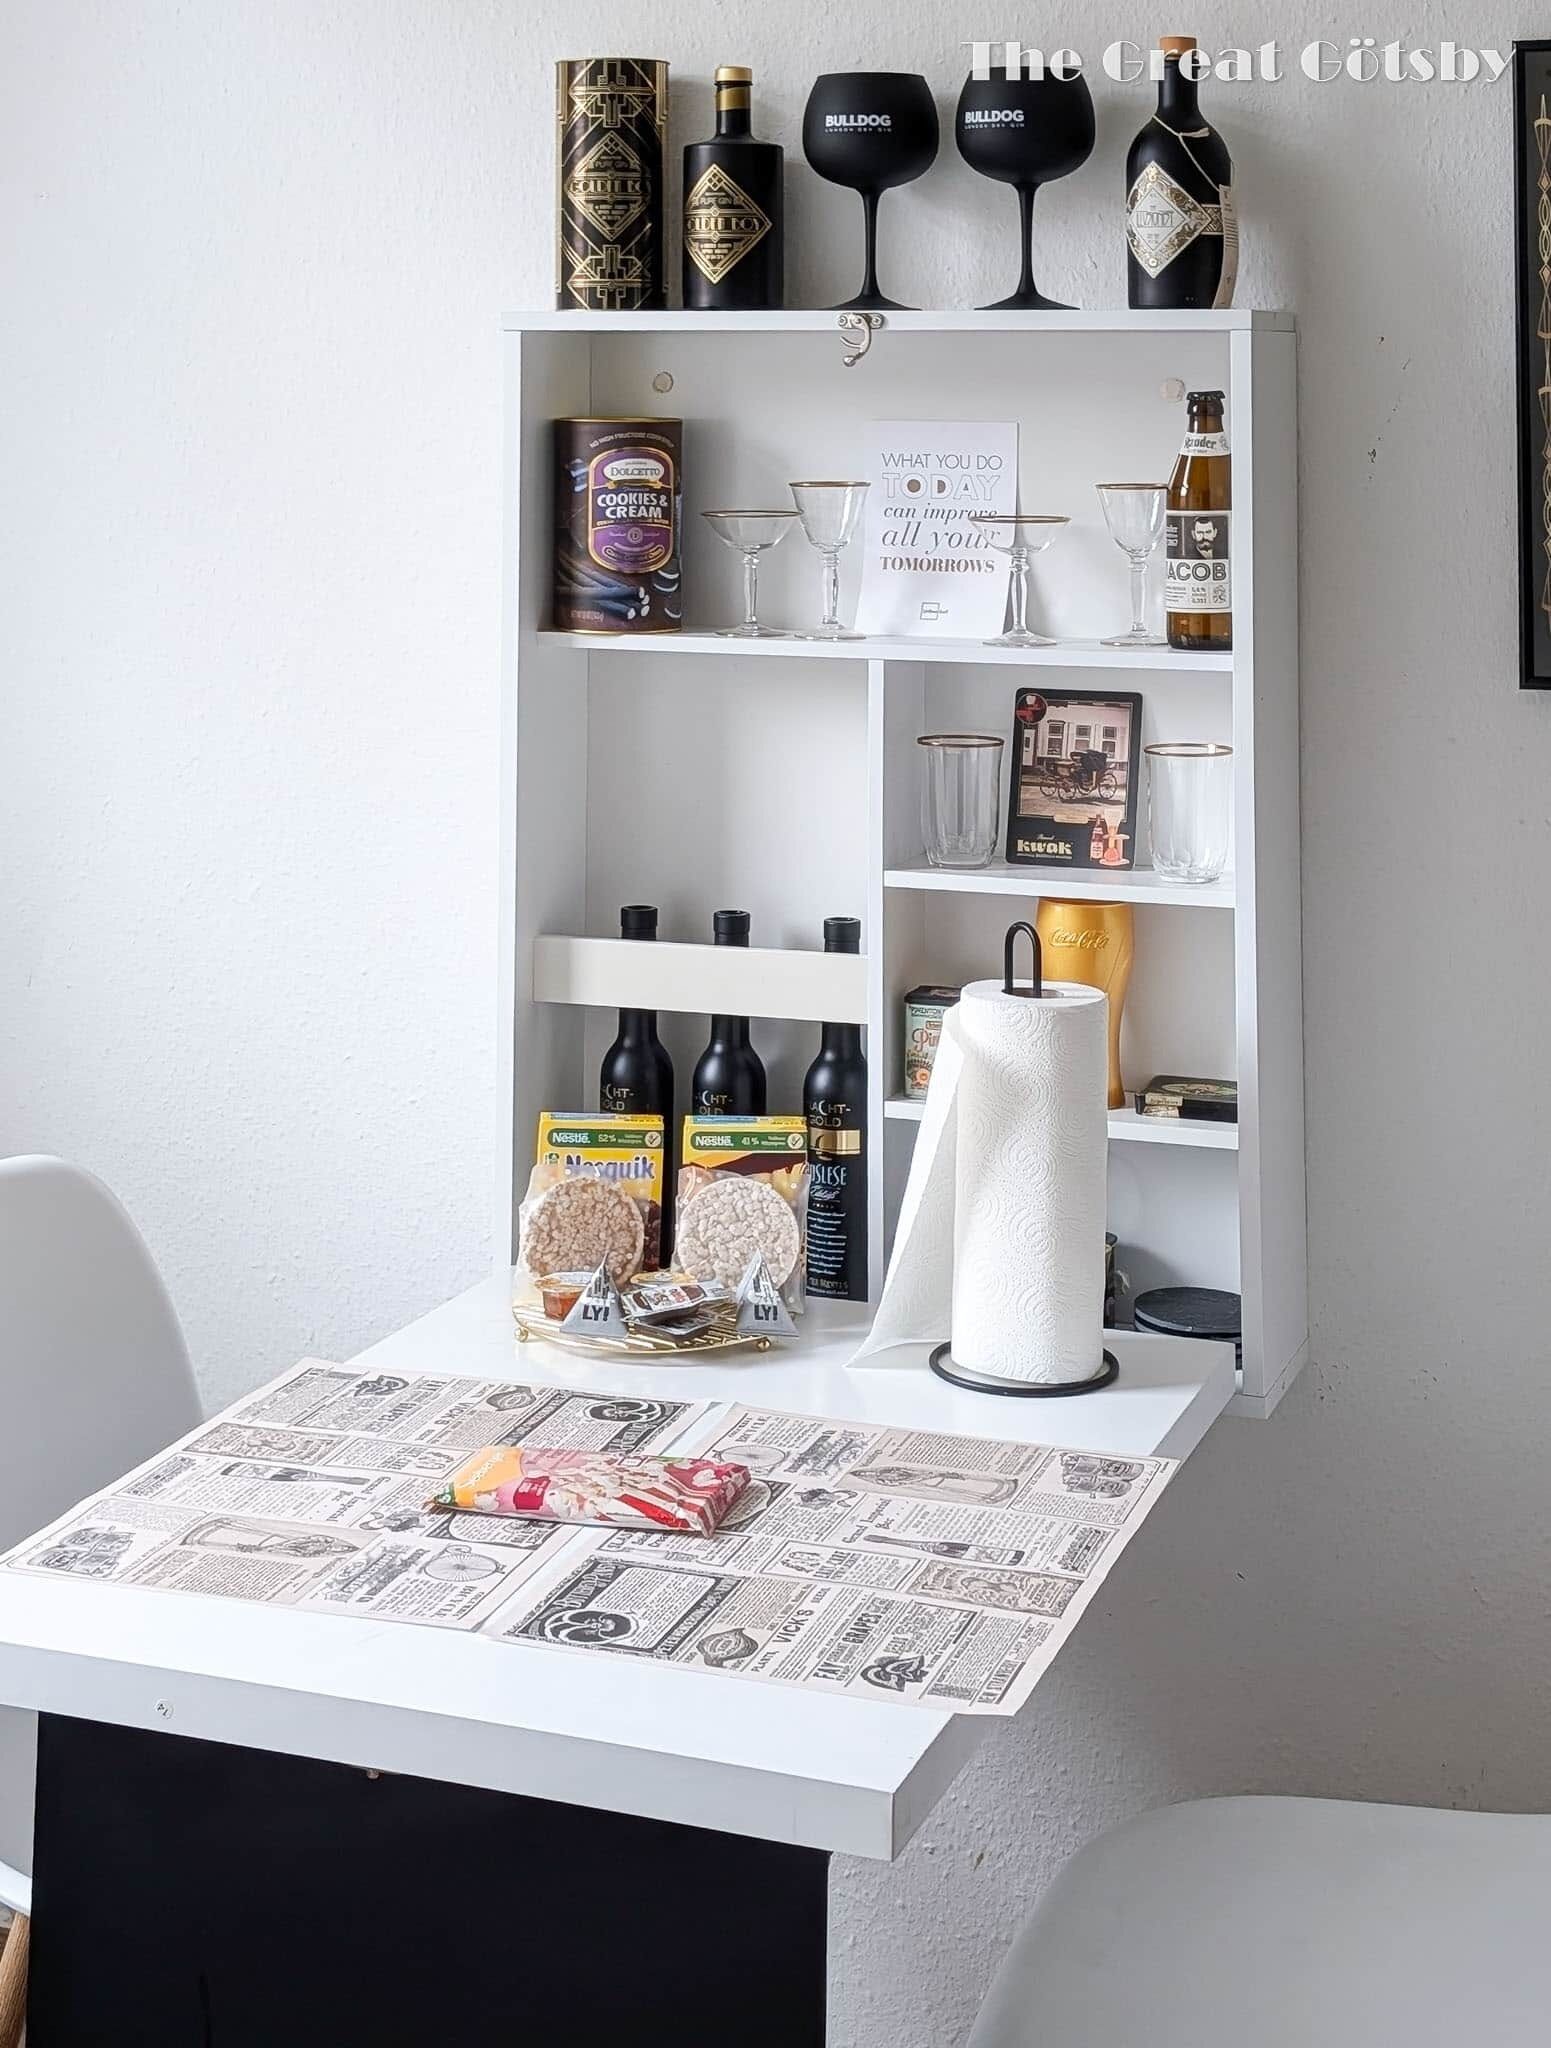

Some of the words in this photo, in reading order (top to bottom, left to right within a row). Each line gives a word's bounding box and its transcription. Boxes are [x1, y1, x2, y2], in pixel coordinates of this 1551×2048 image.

[826, 114, 892, 127] BULLDOG
[965, 110, 1024, 123] BULLDOG
[881, 453, 931, 468] WHAT
[936, 454, 971, 470] YOU
[976, 455, 1003, 470] DO
[881, 473, 1001, 501] TODAY
[597, 492, 657, 507] COOKIES
[659, 494, 668, 507] &
[605, 506, 662, 518] CREAM
[883, 506, 916, 519] can
[923, 503, 998, 525] improve
[882, 521, 921, 547] all
[925, 528, 1001, 554] your
[880, 556, 995, 573] TOMORROWS
[1167, 561, 1227, 581] ACOB
[809, 1164, 847, 1186] USLESE
[772, 1610, 814, 1642] VICK'S
